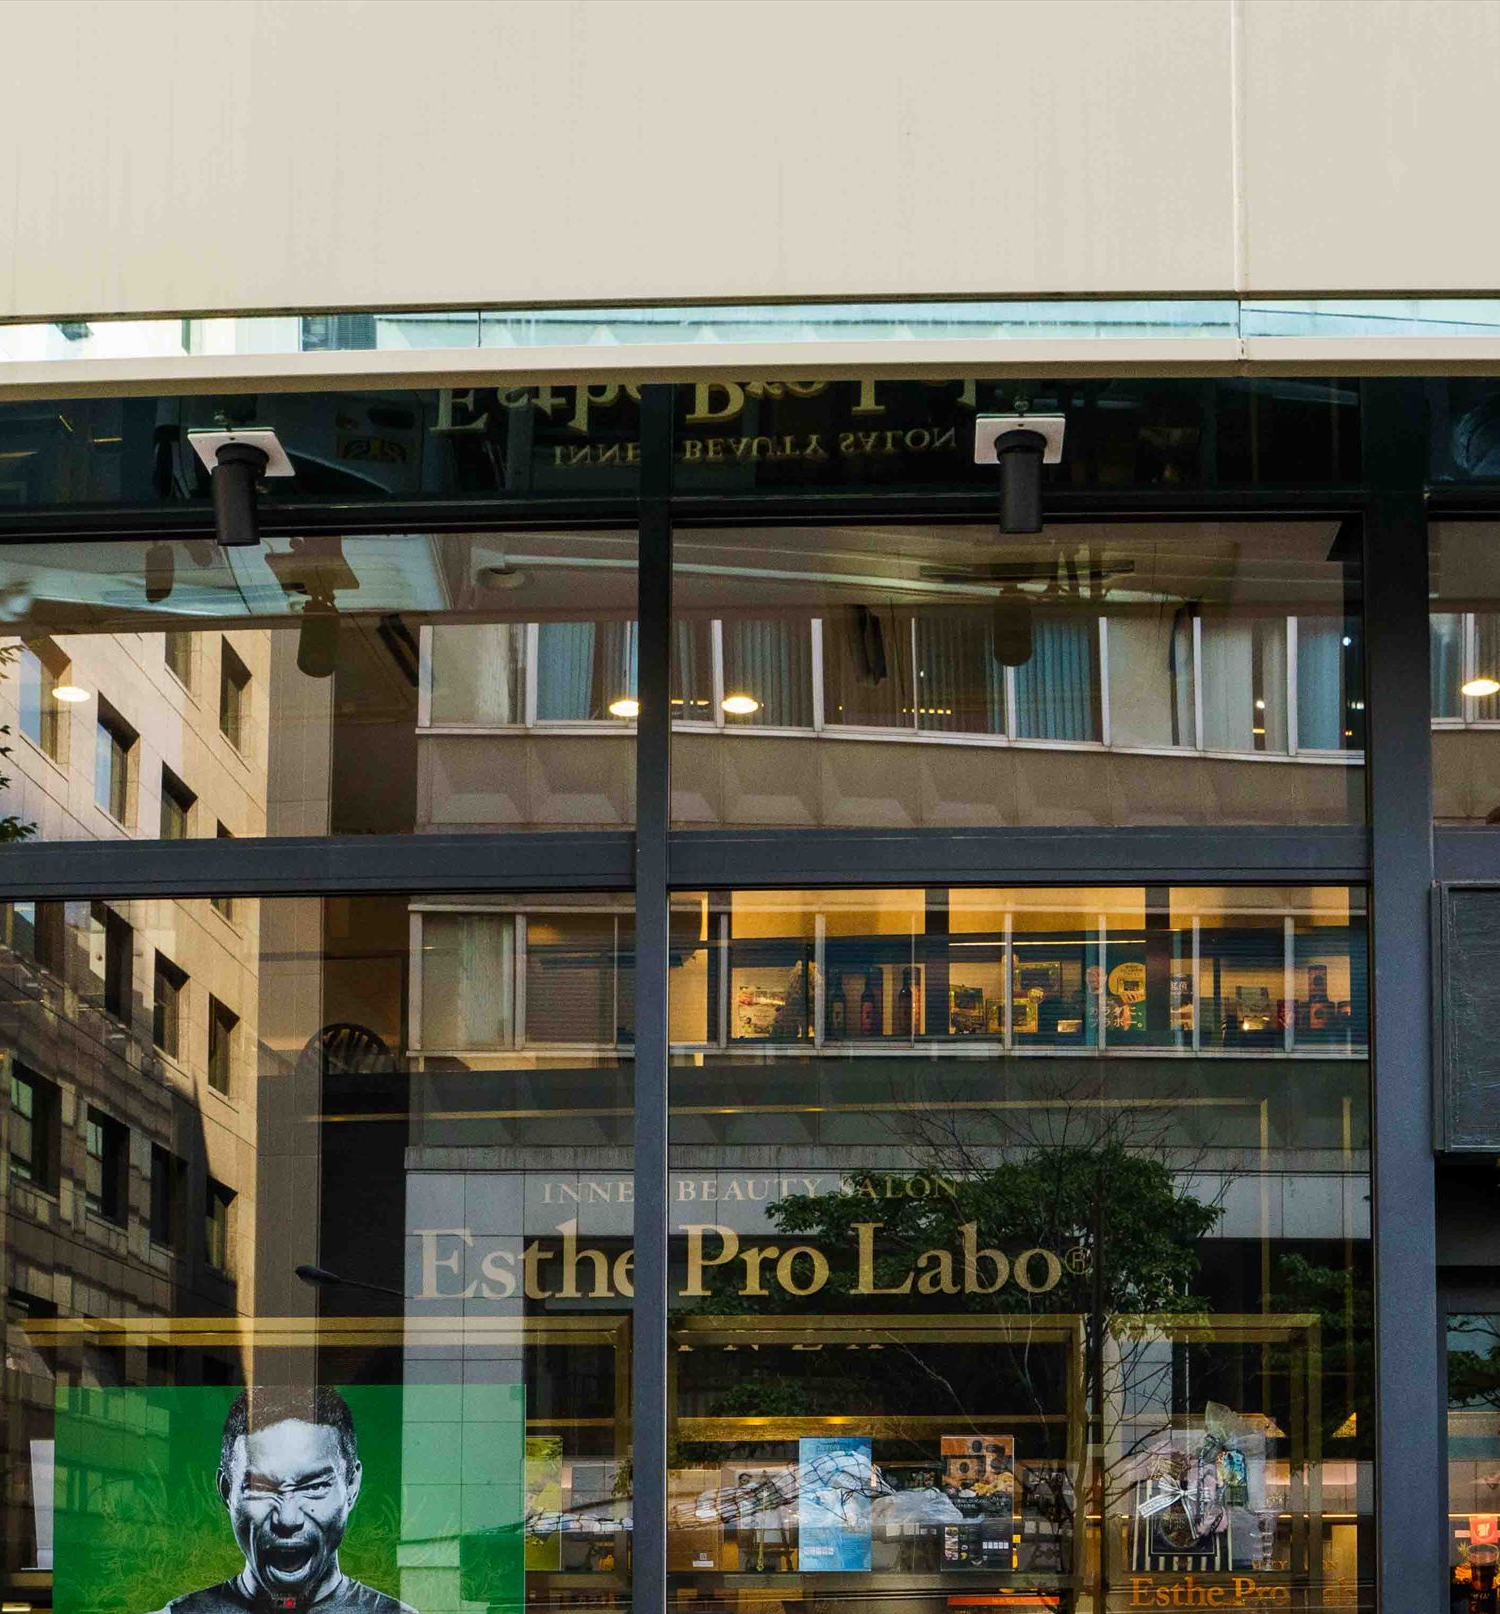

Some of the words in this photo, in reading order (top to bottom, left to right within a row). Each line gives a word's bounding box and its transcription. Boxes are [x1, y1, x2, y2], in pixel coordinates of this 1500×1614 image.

[540, 1181, 634, 1204] INNE
[677, 1178, 821, 1202] BEAUTY
[839, 1176, 959, 1200] SALON
[678, 1223, 830, 1297] Pro
[1130, 1575, 1225, 1608] Esthe
[1232, 1577, 1290, 1608] Pro
